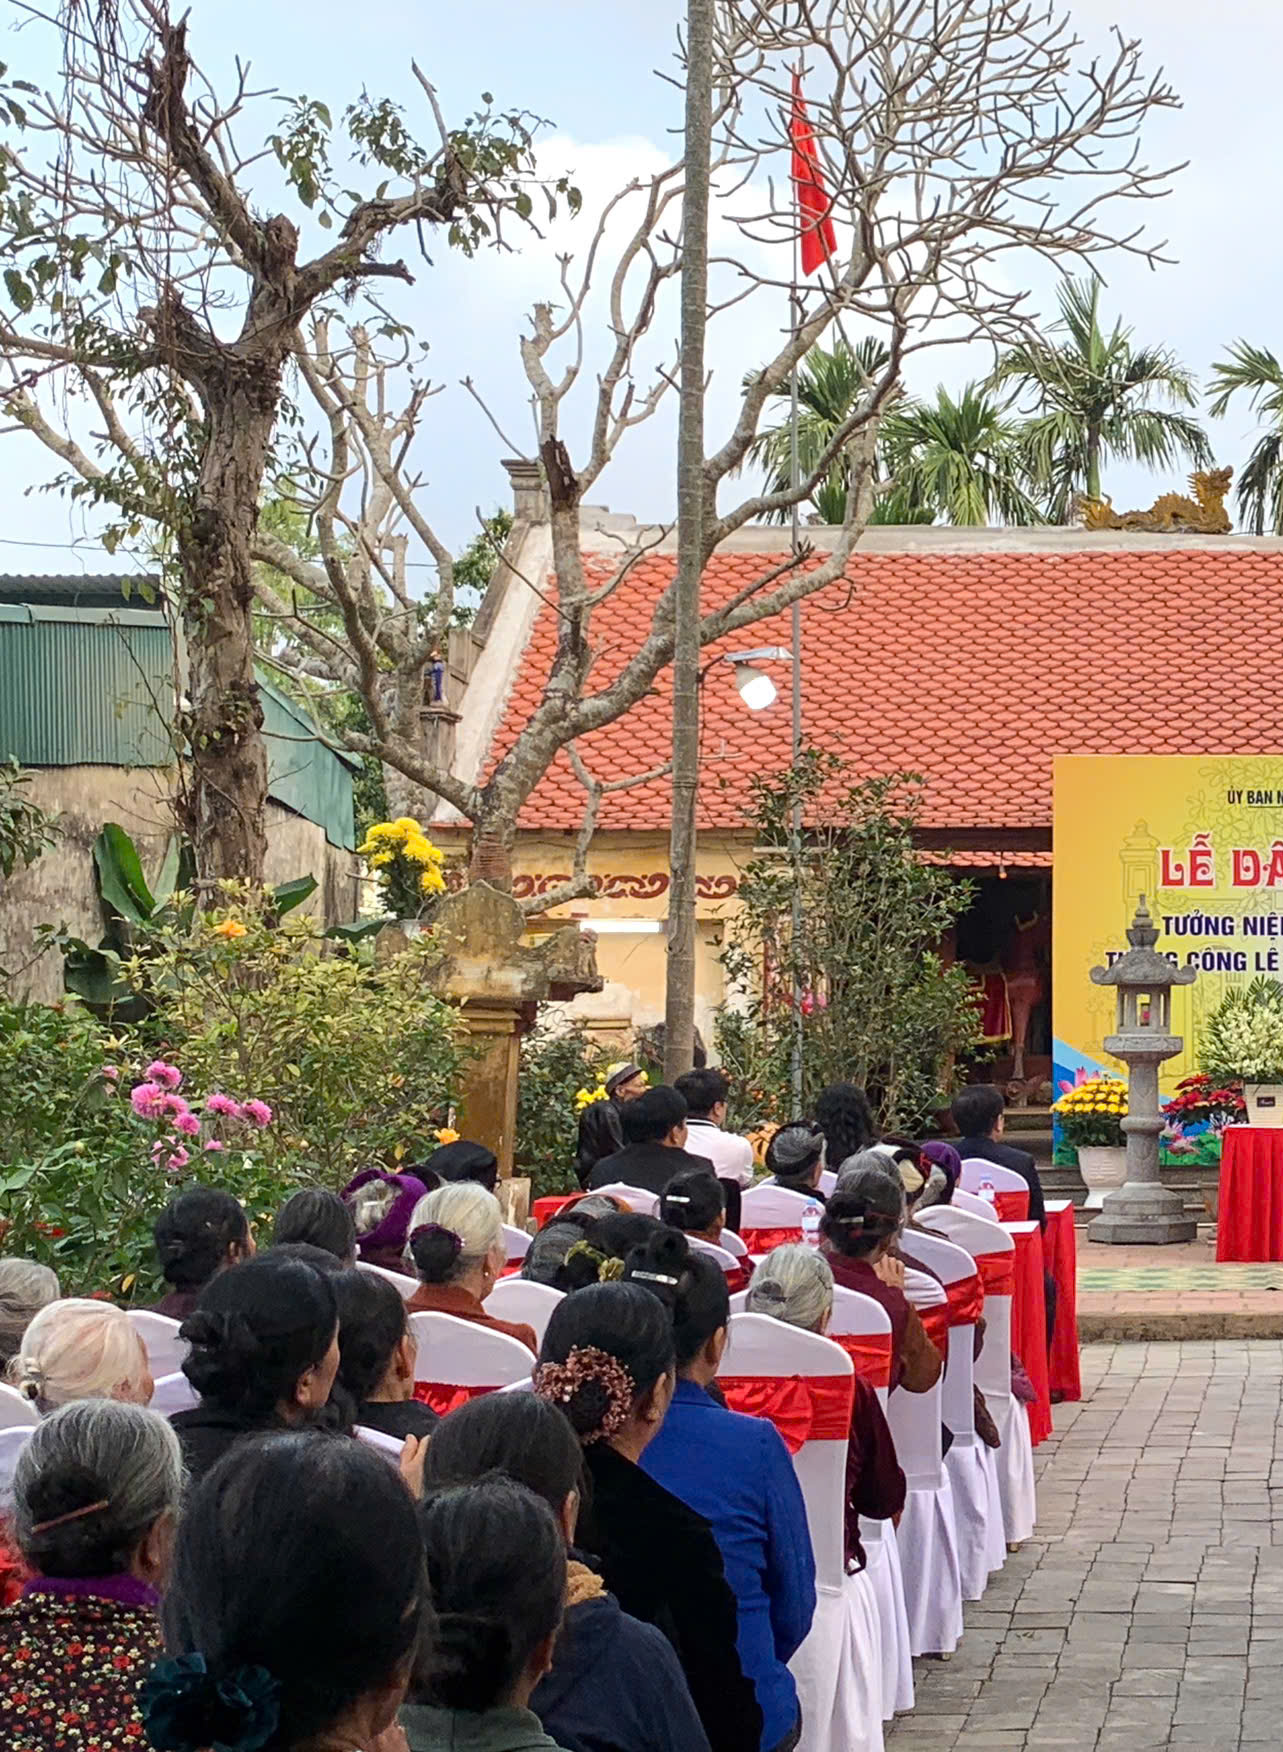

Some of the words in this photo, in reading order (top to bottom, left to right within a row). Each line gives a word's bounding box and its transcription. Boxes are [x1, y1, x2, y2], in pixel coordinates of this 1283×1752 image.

[1227, 785, 1243, 805] ỦY
[1247, 790, 1273, 805] BAN
[1160, 832, 1215, 887] LỄ
[1161, 908, 1235, 936] TƯỞNG
[1186, 946, 1247, 972] CÔNG
[1255, 947, 1279, 972] LÊ
